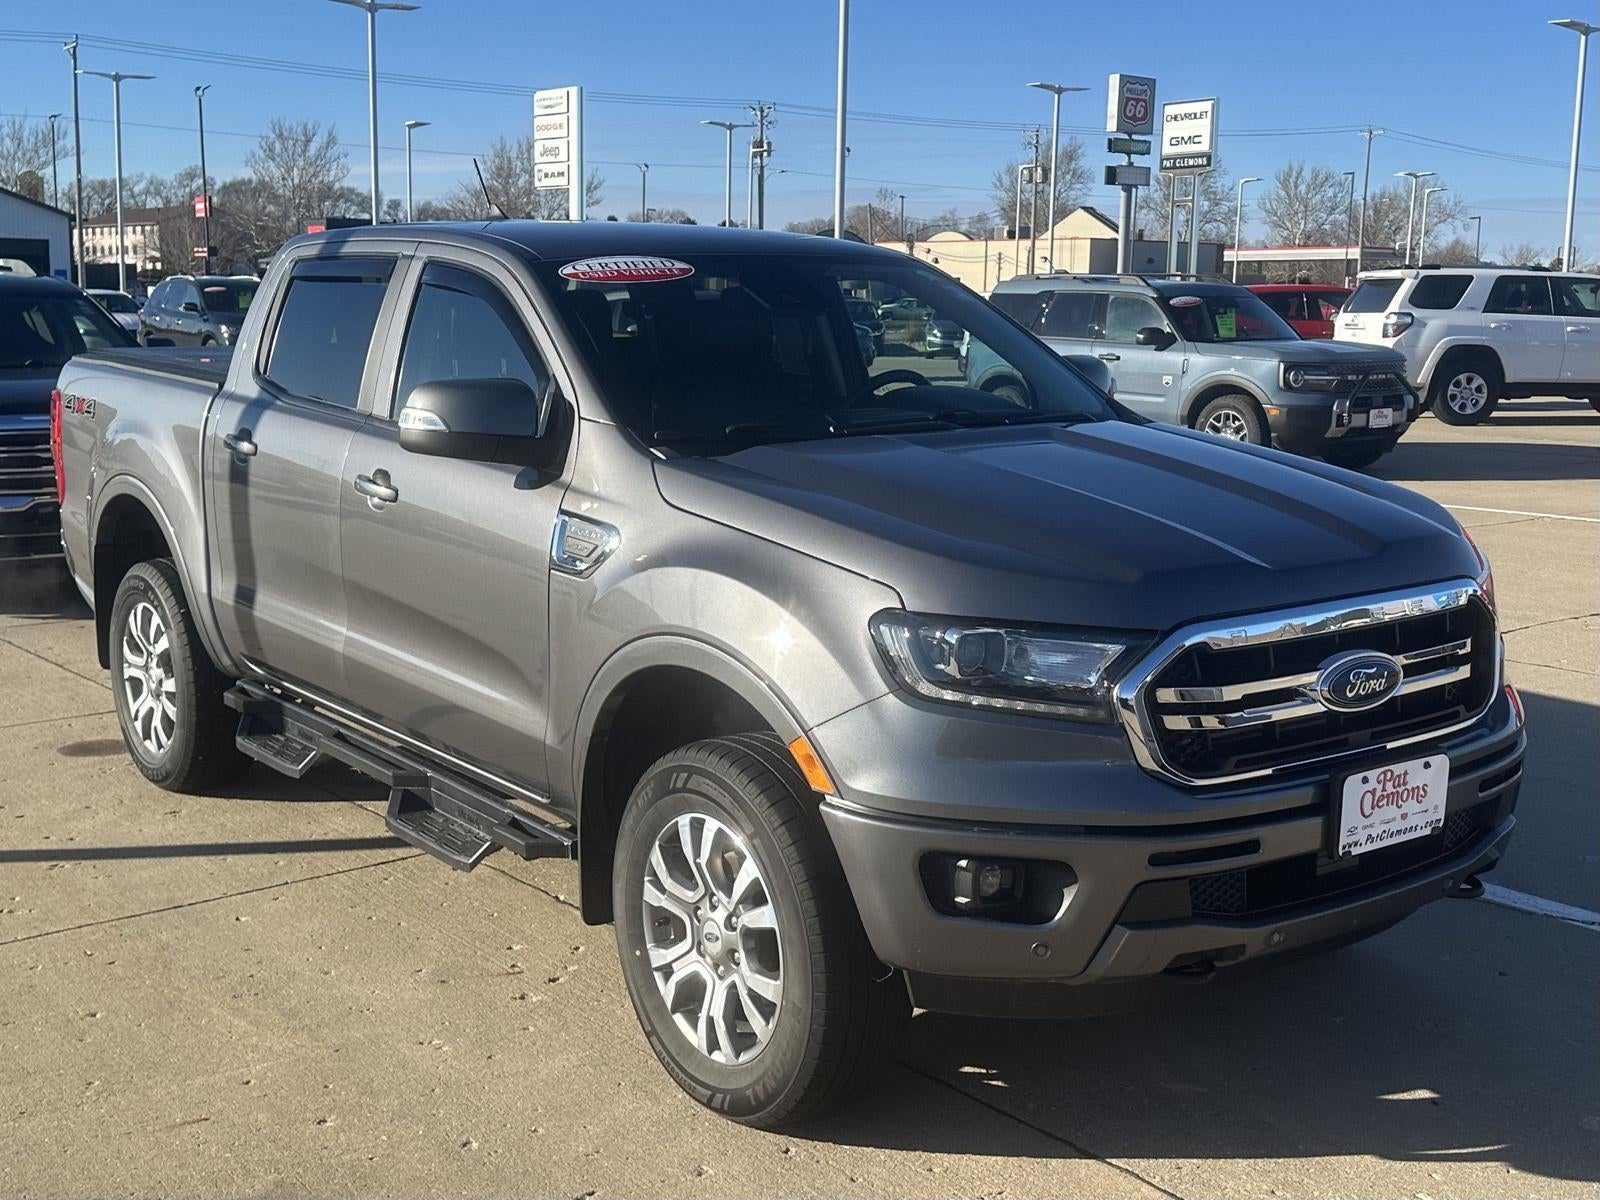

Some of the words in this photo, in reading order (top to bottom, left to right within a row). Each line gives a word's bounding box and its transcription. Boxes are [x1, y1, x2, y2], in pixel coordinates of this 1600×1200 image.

[1126, 86, 1148, 97] PHILLIPS
[1126, 101, 1146, 118] 66
[1165, 110, 1208, 122] CHEVROLET
[536, 122, 564, 132] DODGE
[1169, 134, 1202, 146] GMC
[540, 144, 560, 158] Jeep
[1163, 159, 1174, 168] PAT
[1176, 157, 1207, 167] CLEMONS
[543, 171, 565, 179] RAM
[572, 260, 676, 272] CERTIFIED
[577, 269, 618, 279] USED
[619, 267, 682, 277] VEHICLE
[1346, 667, 1388, 698] Ford
[1376, 768, 1409, 792] Pat
[1359, 783, 1429, 819] Clemons
